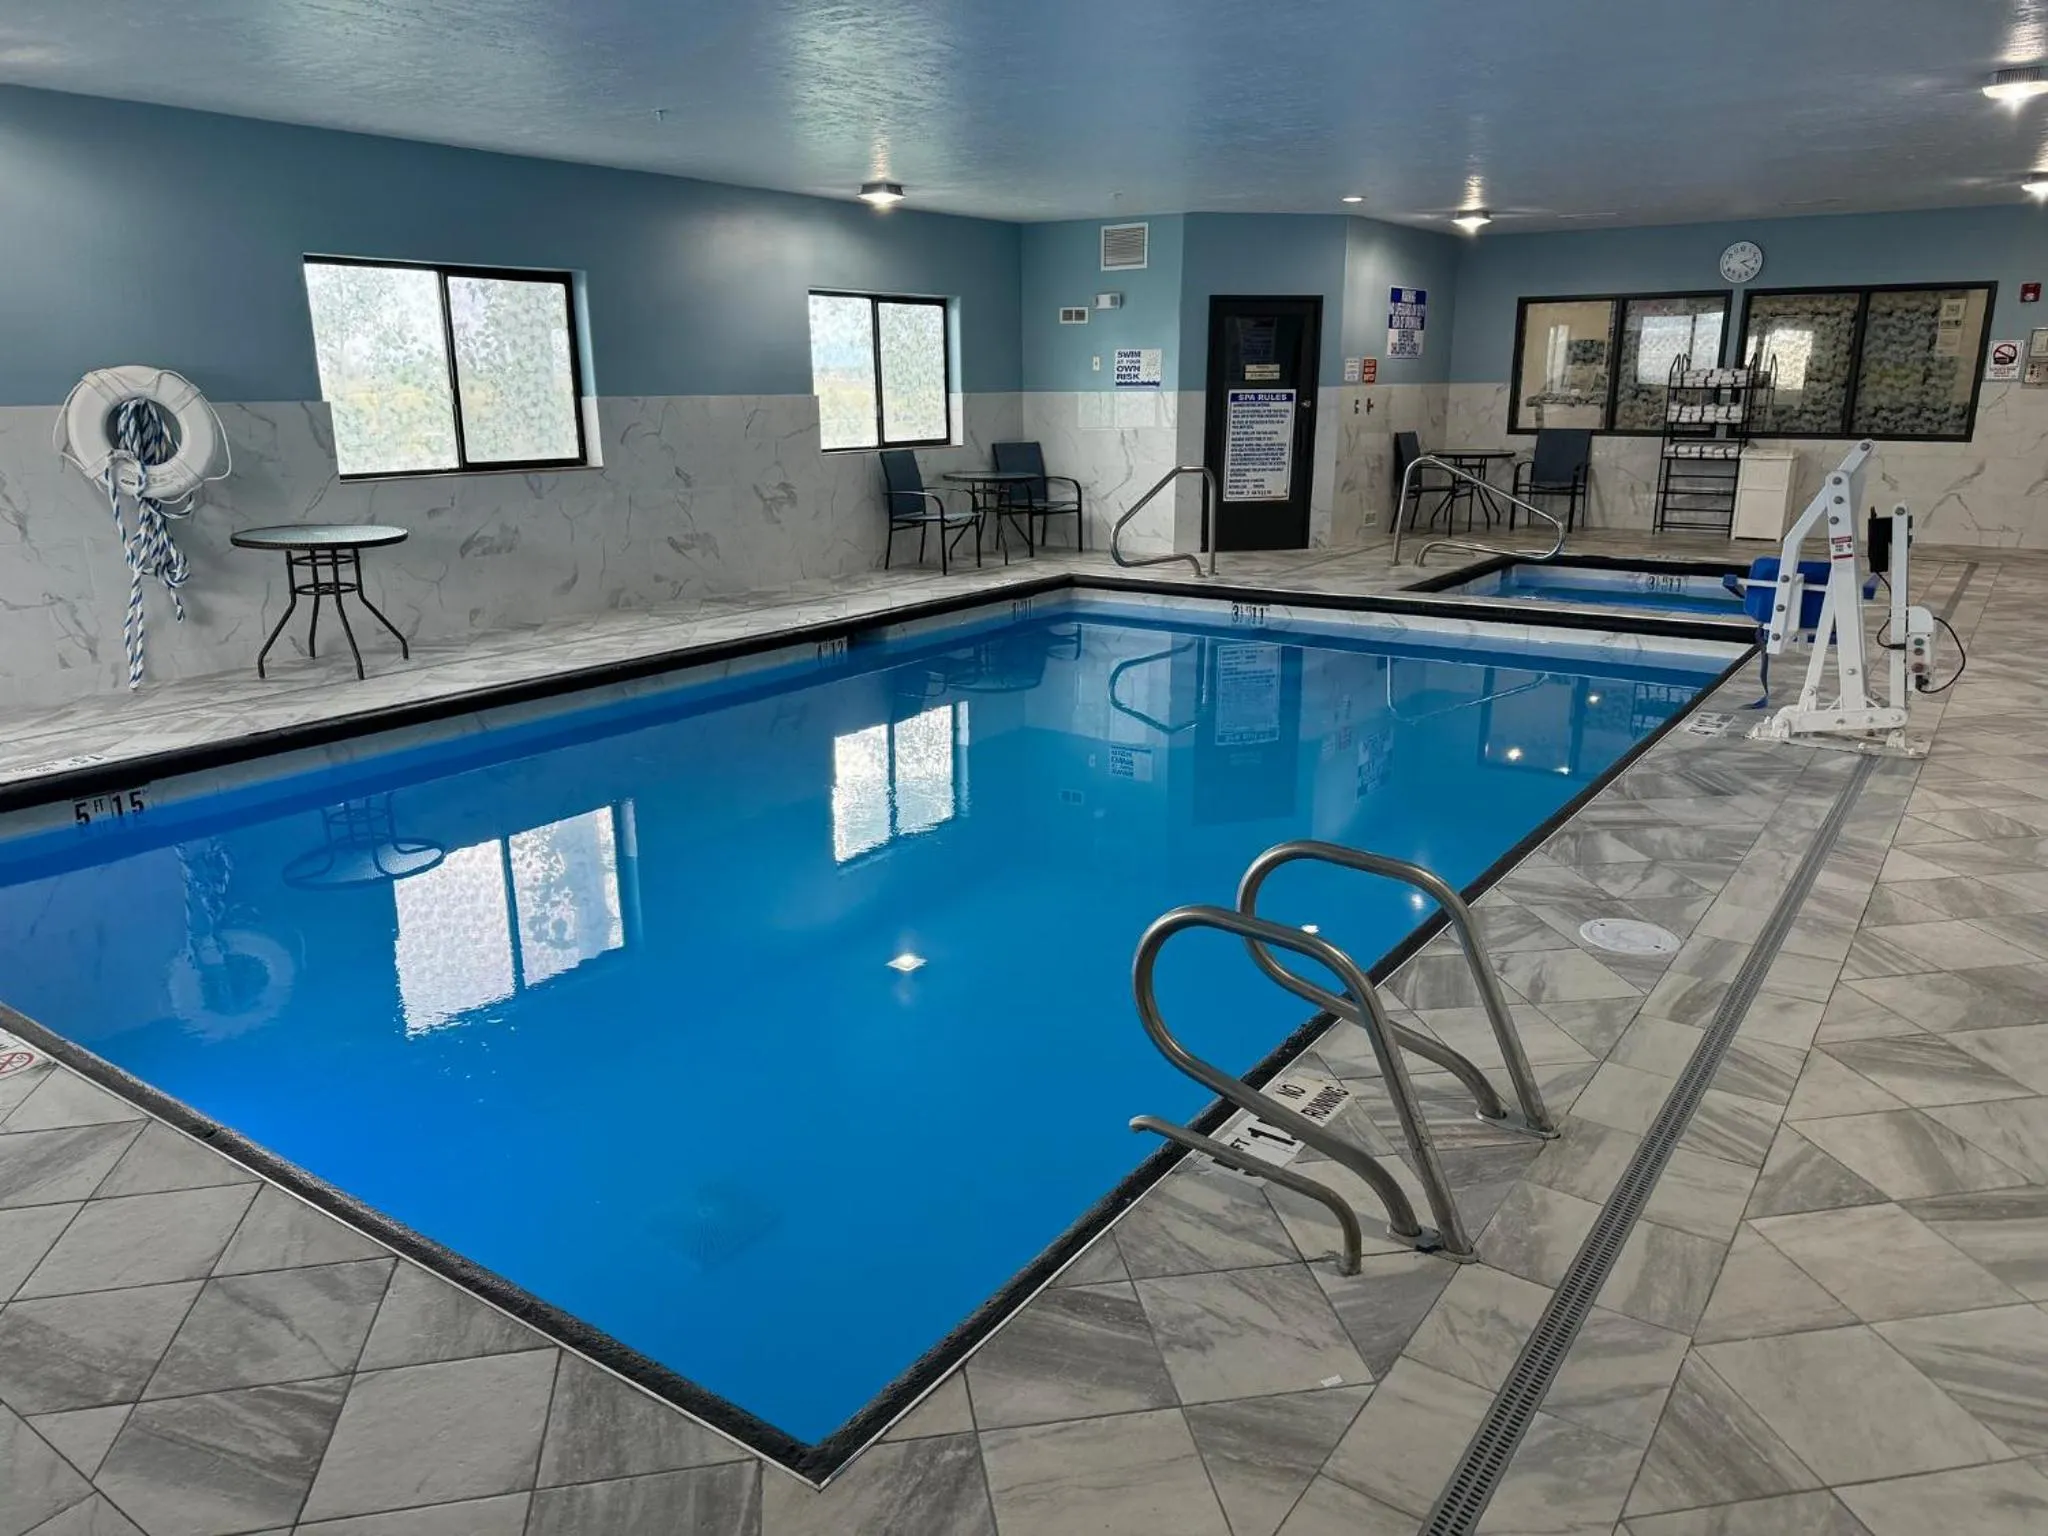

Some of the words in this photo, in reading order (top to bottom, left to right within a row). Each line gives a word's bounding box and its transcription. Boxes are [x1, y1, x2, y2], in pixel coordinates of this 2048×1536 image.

[1117, 350, 1141, 359] SWIM
[1116, 372, 1141, 380] RISK
[1238, 393, 1256, 401] SPA
[1258, 393, 1288, 401] RULES
[75, 802, 90, 825] 5
[94, 799, 104, 813] FT
[1276, 1083, 1306, 1100] NO
[1300, 1086, 1350, 1120] RUNNING
[1230, 1138, 1250, 1151] FT
